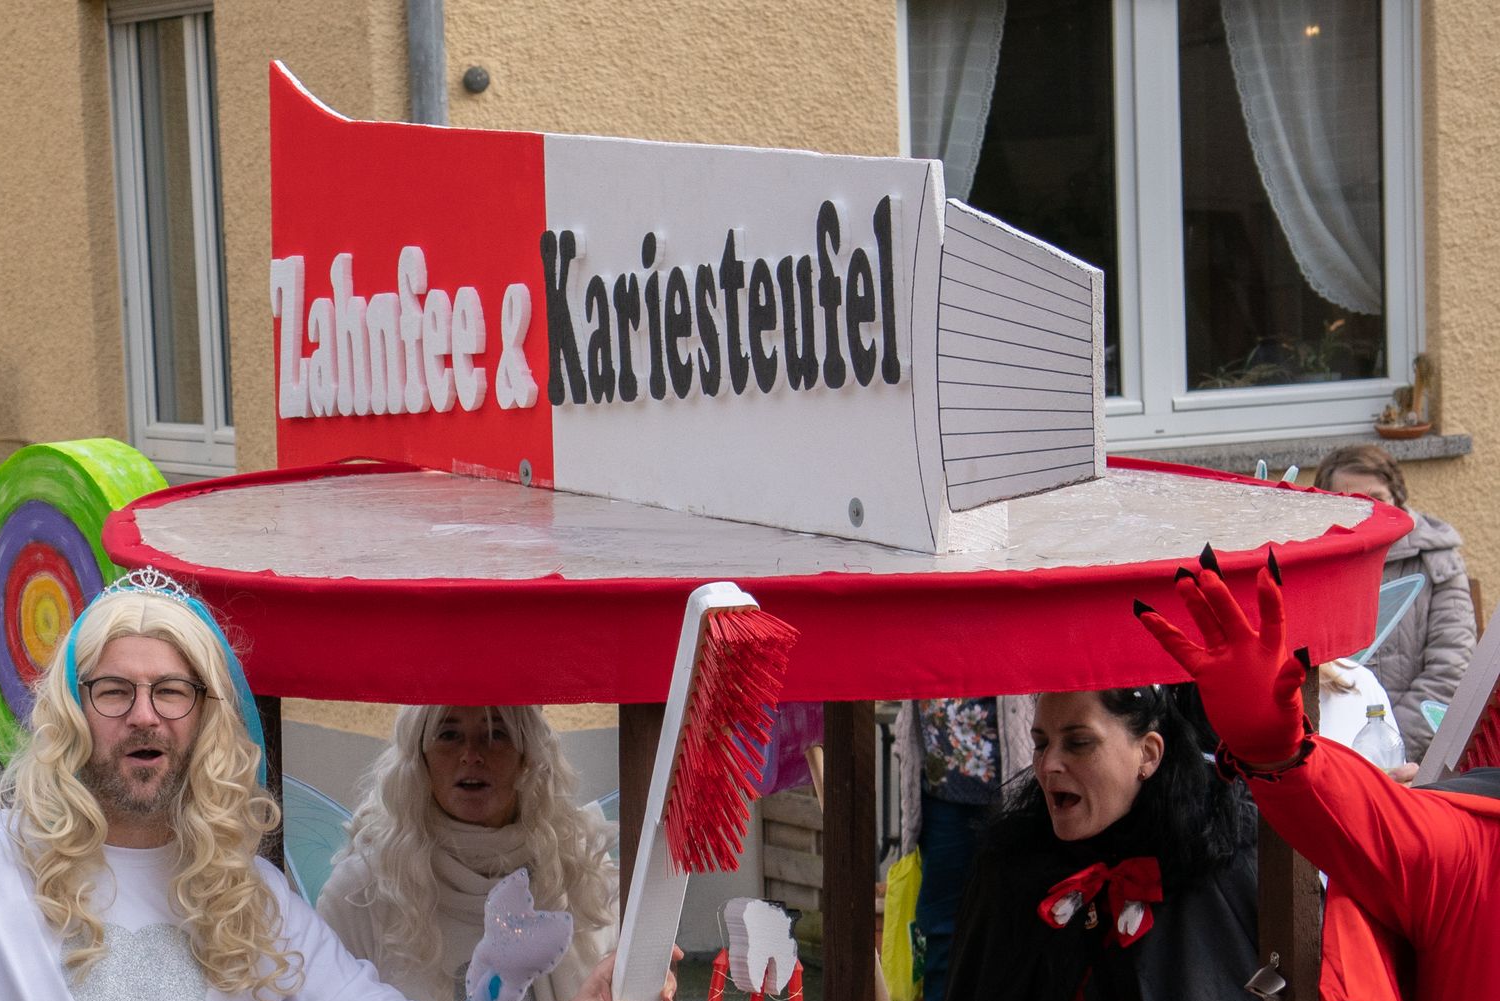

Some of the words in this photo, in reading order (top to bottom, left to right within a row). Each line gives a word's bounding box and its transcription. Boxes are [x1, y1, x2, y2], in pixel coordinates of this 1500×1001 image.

[270, 246, 487, 419] Zahnfee
[495, 283, 539, 410] &
[540, 195, 901, 406] Kariesteufel
